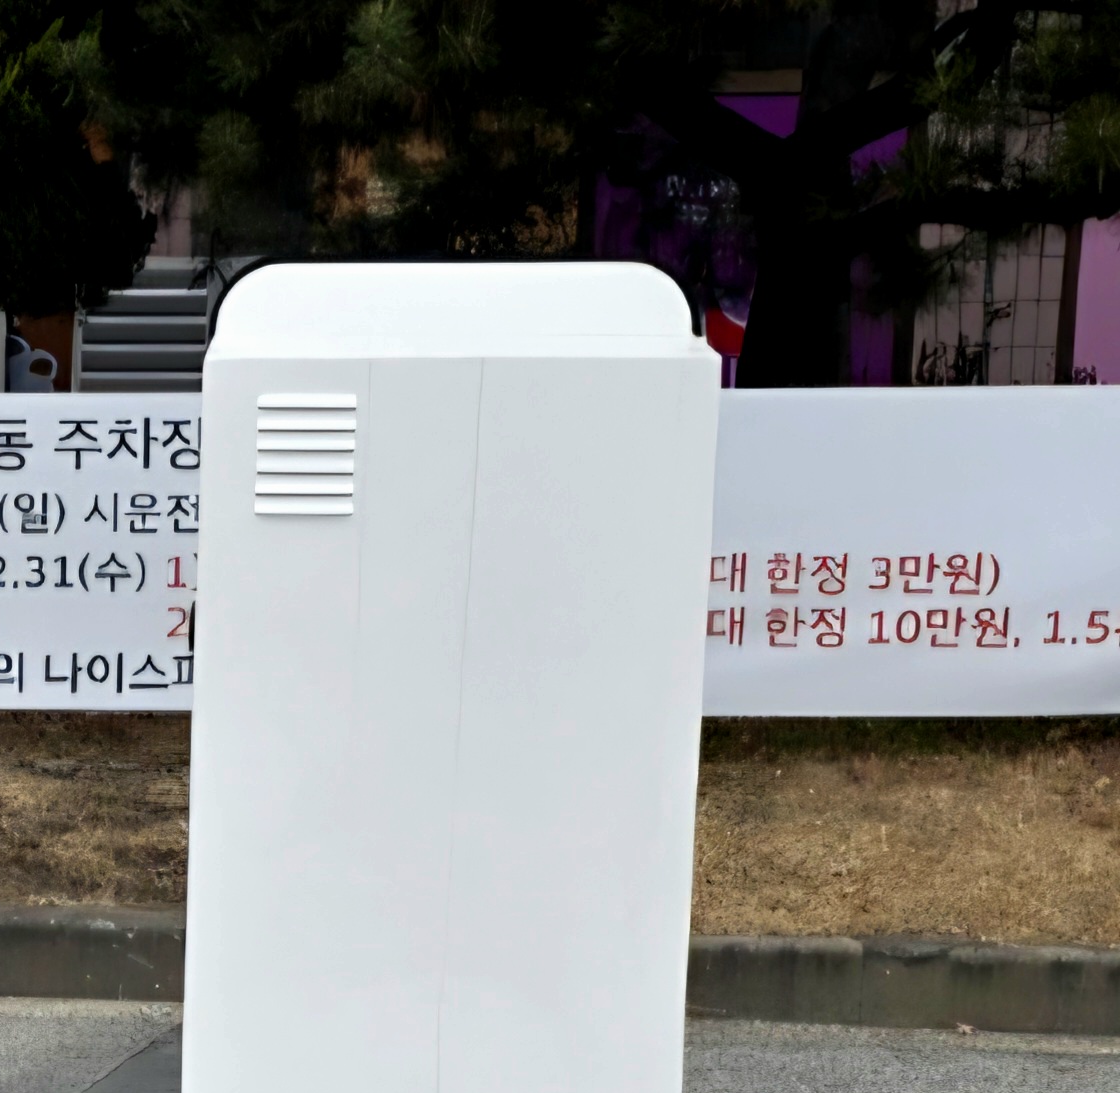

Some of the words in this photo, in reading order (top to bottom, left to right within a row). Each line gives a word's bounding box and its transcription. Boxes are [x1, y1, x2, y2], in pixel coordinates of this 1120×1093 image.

[767, 552, 848, 596] 한정
[868, 551, 1001, 596] 3만원)
[765, 606, 846, 648] 한정
[1043, 610, 1120, 645] 1.5
